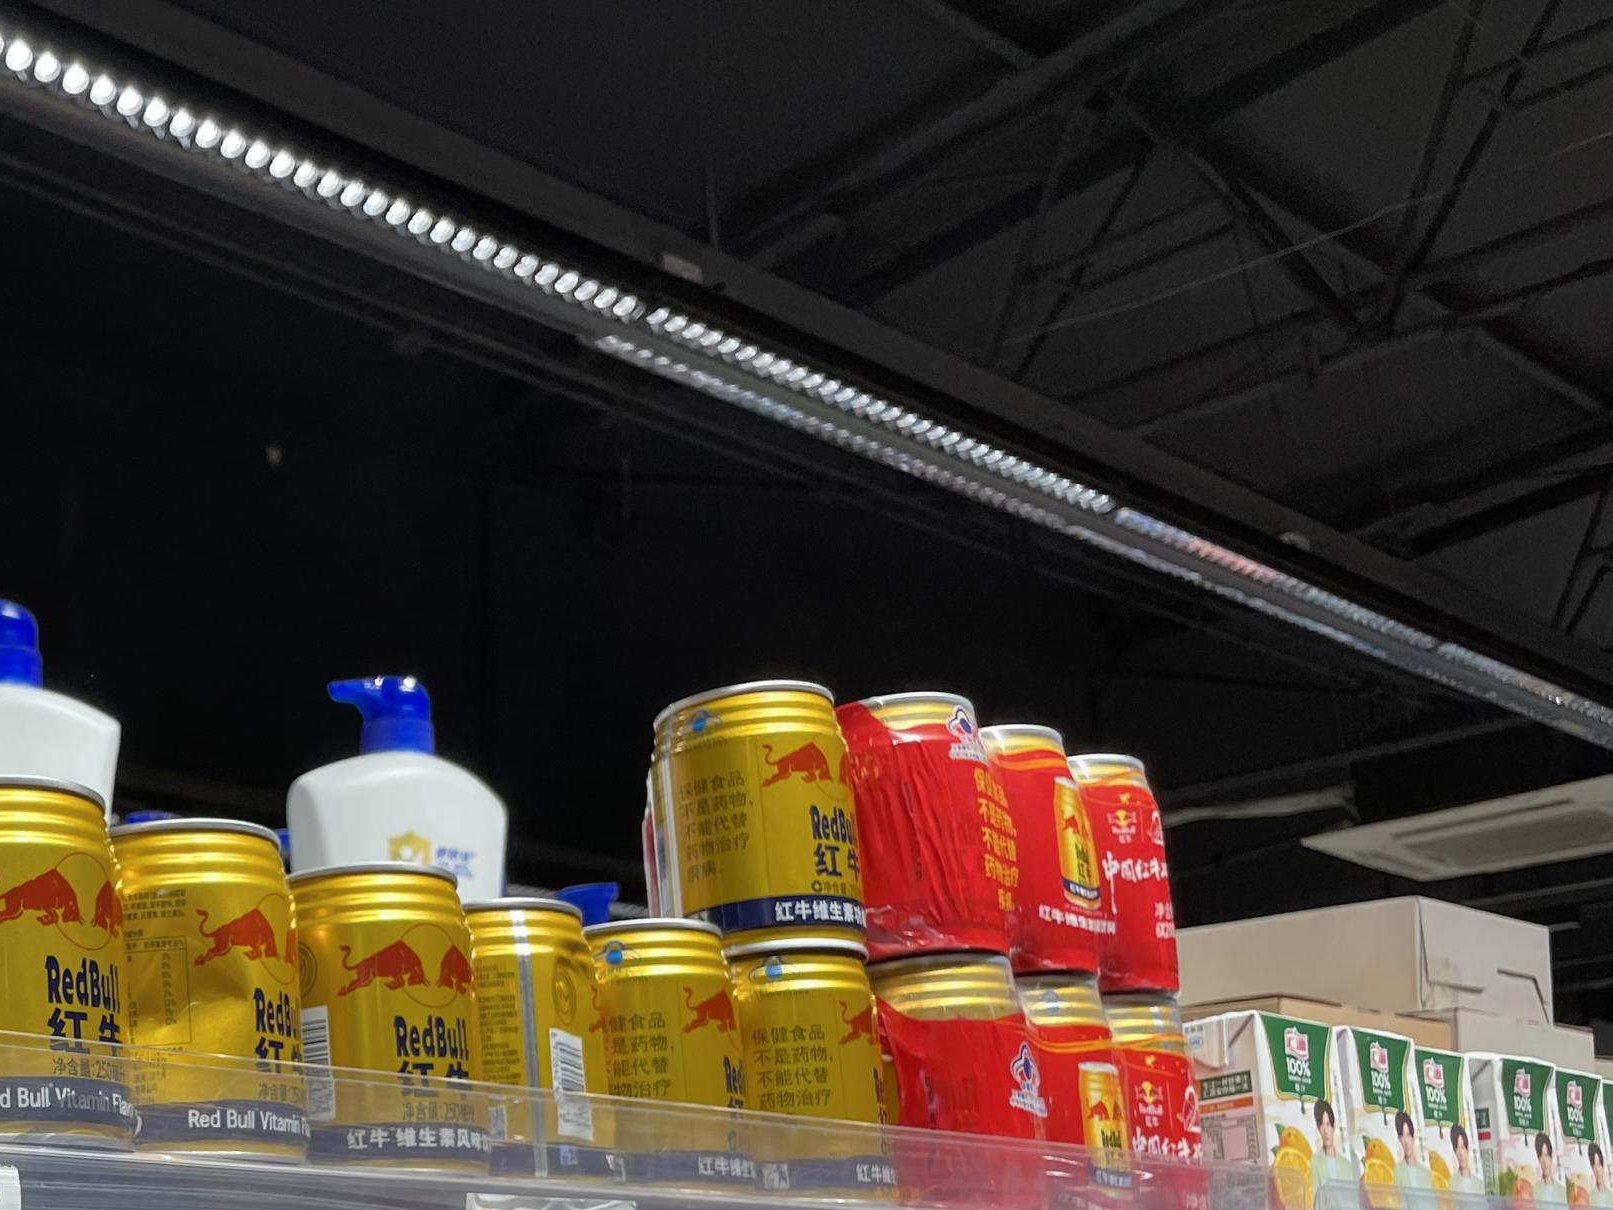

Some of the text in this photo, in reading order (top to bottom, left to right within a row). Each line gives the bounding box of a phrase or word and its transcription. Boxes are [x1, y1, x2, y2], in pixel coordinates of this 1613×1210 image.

[47, 1008, 124, 1055] 红牛
[393, 1015, 469, 1060] RedBull
[751, 1024, 826, 1046] 保健食品
[1285, 1057, 1312, 1077] 100%
[756, 1068, 829, 1089] 不能代替
[1370, 1070, 1392, 1089] 100%
[17, 1086, 50, 1109] Bull
[54, 1087, 111, 1113] Vitamin
[758, 1088, 832, 1110] 药物治疗
[1425, 1085, 1448, 1105] 100%
[1513, 1094, 1532, 1113] 100%
[188, 1109, 301, 1134] Red Bull Vitamin
[1566, 1105, 1584, 1123] 100%
